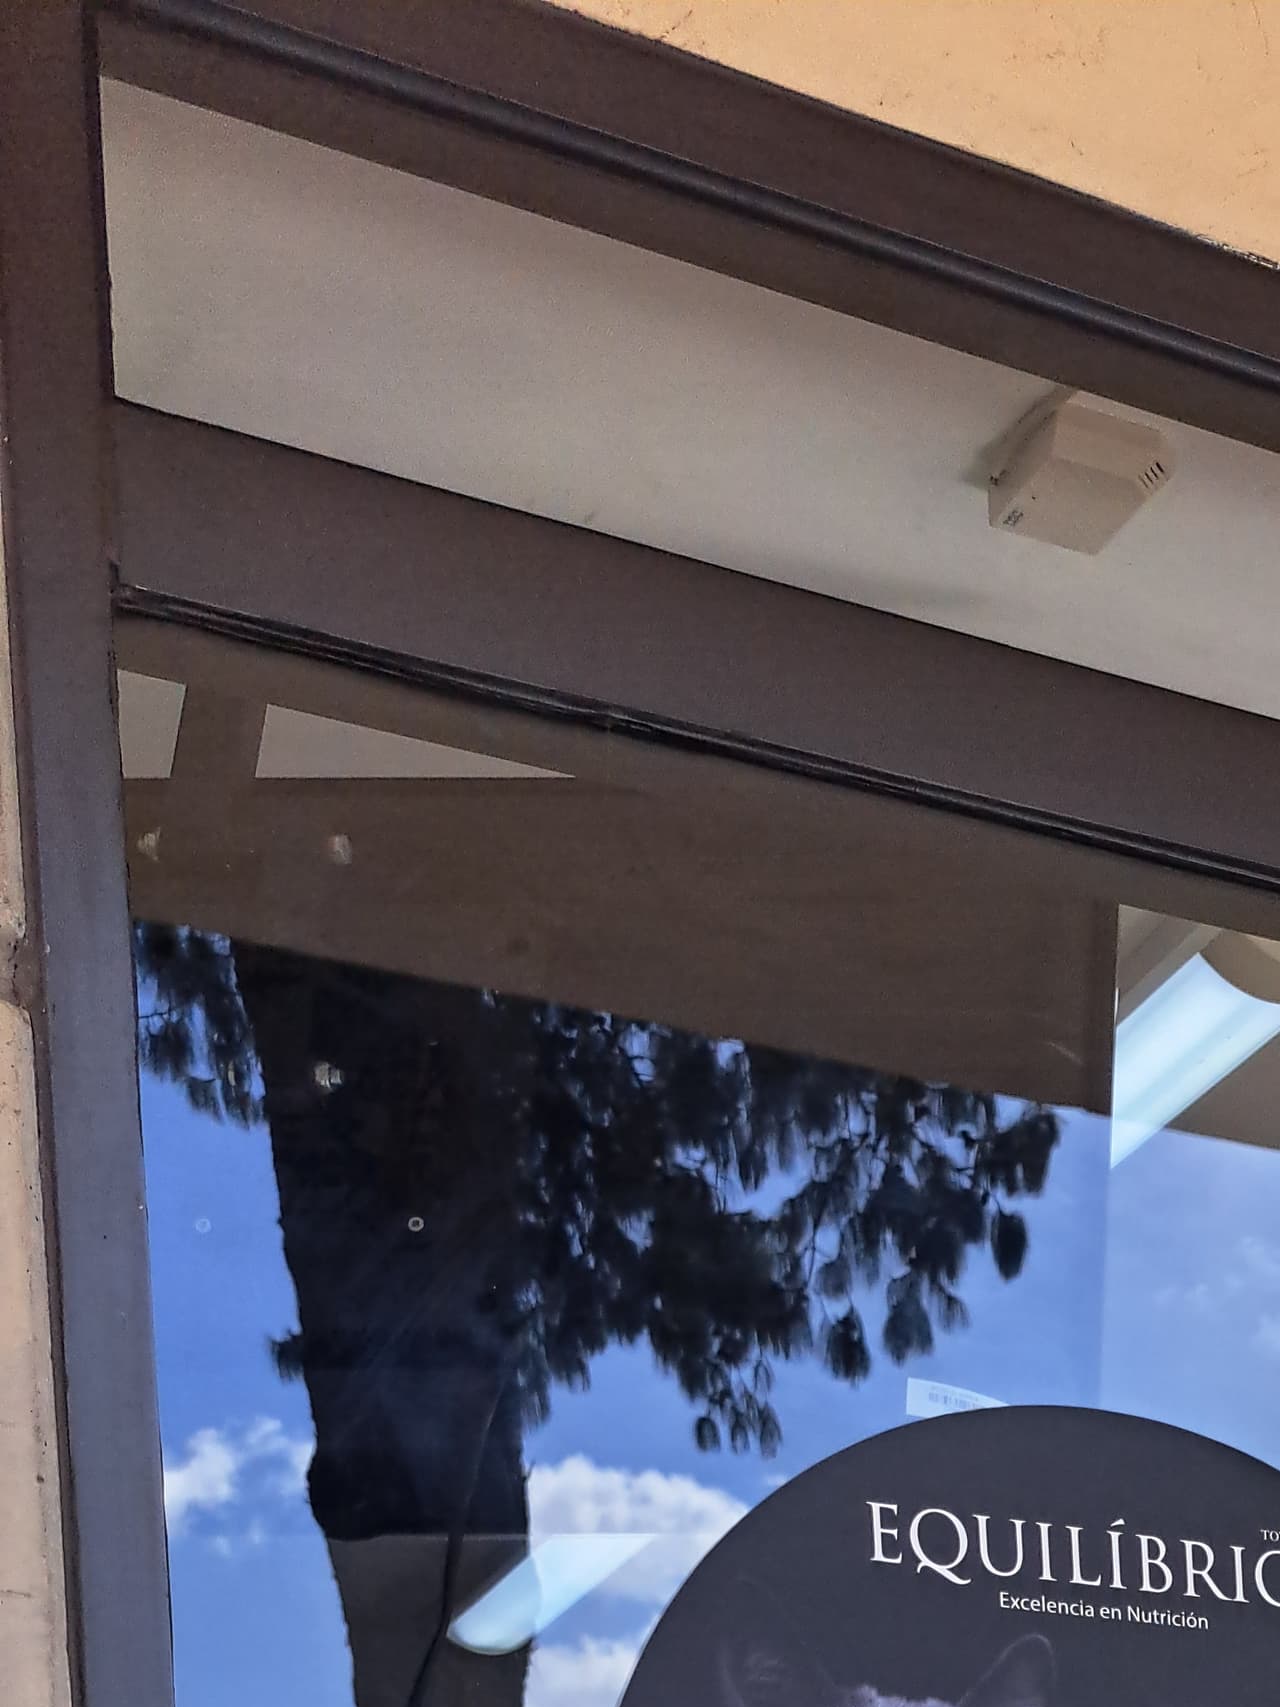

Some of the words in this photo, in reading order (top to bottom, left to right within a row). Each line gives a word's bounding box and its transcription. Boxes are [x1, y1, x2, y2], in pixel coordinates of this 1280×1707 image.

[1000, 1591, 1094, 1618] Excelencia
[1100, 1606, 1122, 1620] en
[1128, 1605, 1209, 1629] Nutrición
